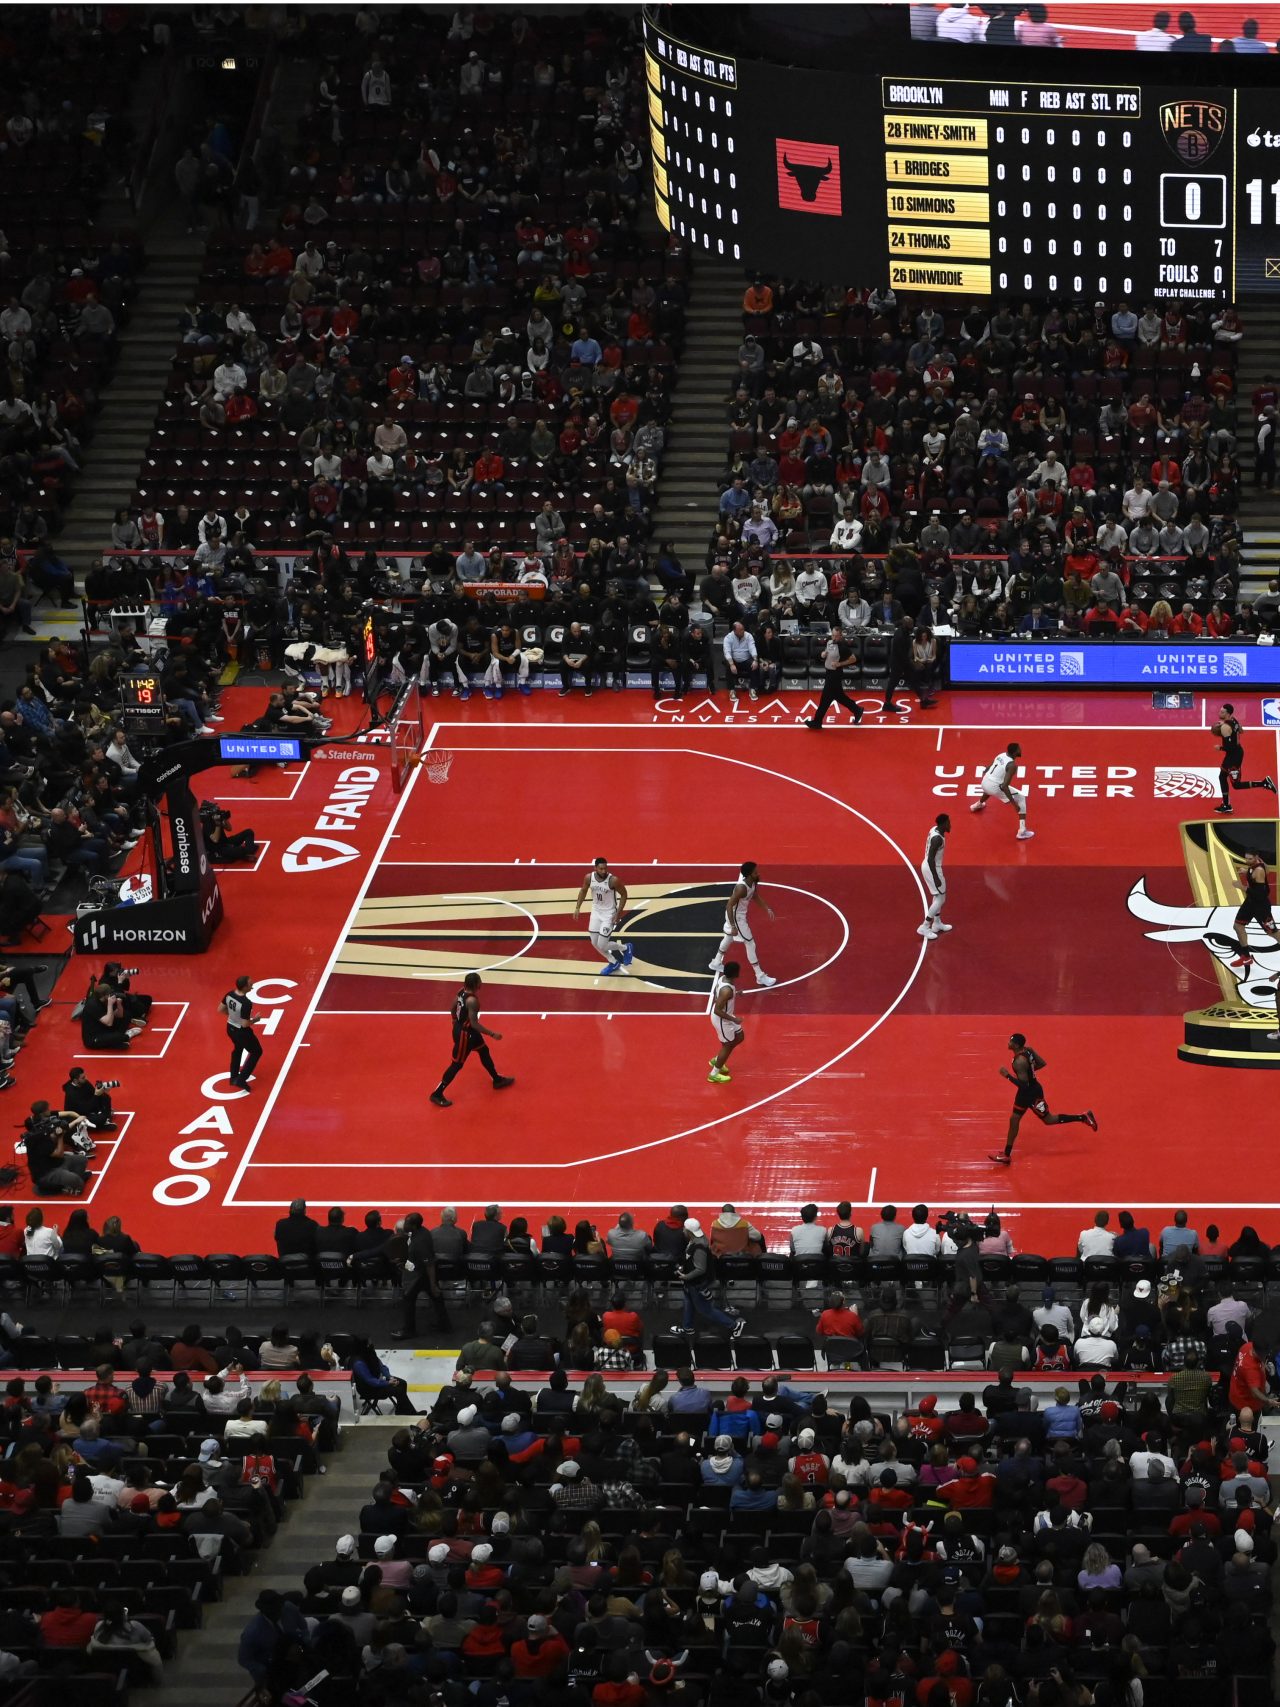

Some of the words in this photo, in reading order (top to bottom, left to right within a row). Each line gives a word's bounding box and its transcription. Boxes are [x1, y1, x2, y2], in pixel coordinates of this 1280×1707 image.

[689, 53, 701, 73] AST
[703, 58, 717, 78] STL
[719, 62, 734, 83] PTS
[889, 85, 943, 105] BROOKLYN
[990, 90, 1009, 107] MIN
[1022, 91, 1028, 107] F
[1040, 91, 1060, 109] REB
[1065, 92, 1085, 110] AST
[1092, 93, 1112, 110] STL
[1117, 94, 1137, 111] PTS
[1164, 104, 1223, 132] NETS
[887, 122, 901, 138] 28
[904, 123, 976, 141] FINNEY-SMITH
[997, 127, 1004, 143] 0
[1022, 128, 1029, 144] 0
[1047, 129, 1054, 145] 0
[1072, 130, 1080, 146] 0
[1098, 131, 1105, 146] 0
[1123, 132, 1131, 147] 0
[893, 160, 899, 174] 1
[905, 160, 950, 177] BRIDGES
[891, 196, 904, 211] 10
[906, 197, 955, 214] SIMMONS
[1185, 182, 1201, 221] 0
[891, 232, 906, 247] 24
[907, 233, 951, 250] THOMAS
[1159, 238, 1176, 257] TO
[1214, 239, 1223, 258] 7
[893, 268, 906, 283] 26
[908, 269, 963, 286] DINWIDDIE
[1159, 264, 1199, 283] FOULS
[1214, 265, 1223, 284] 0
[1154, 287, 1179, 298] REPLAY
[1179, 288, 1216, 299] CHALLENGE
[476, 588, 522, 597] GATORAD
[223, 611, 239, 619] SEE
[522, 626, 539, 643] G
[632, 627, 646, 643] G
[993, 653, 1055, 663] UNITED
[1157, 654, 1218, 664] UNITED
[978, 664, 1055, 674] AIRLINES
[1141, 665, 1218, 675] AIRLINES
[137, 689, 152, 703] 19
[654, 698, 912, 714] CALAMOS
[651, 715, 910, 724] INVESTMENTS
[226, 745, 277, 753] UNITED
[156, 763, 182, 783] coinbase
[990, 764, 998, 775] 1
[175, 817, 190, 874] coinbase
[113, 928, 187, 942] HORIZON
[152, 978, 299, 1205] CHCAGO
